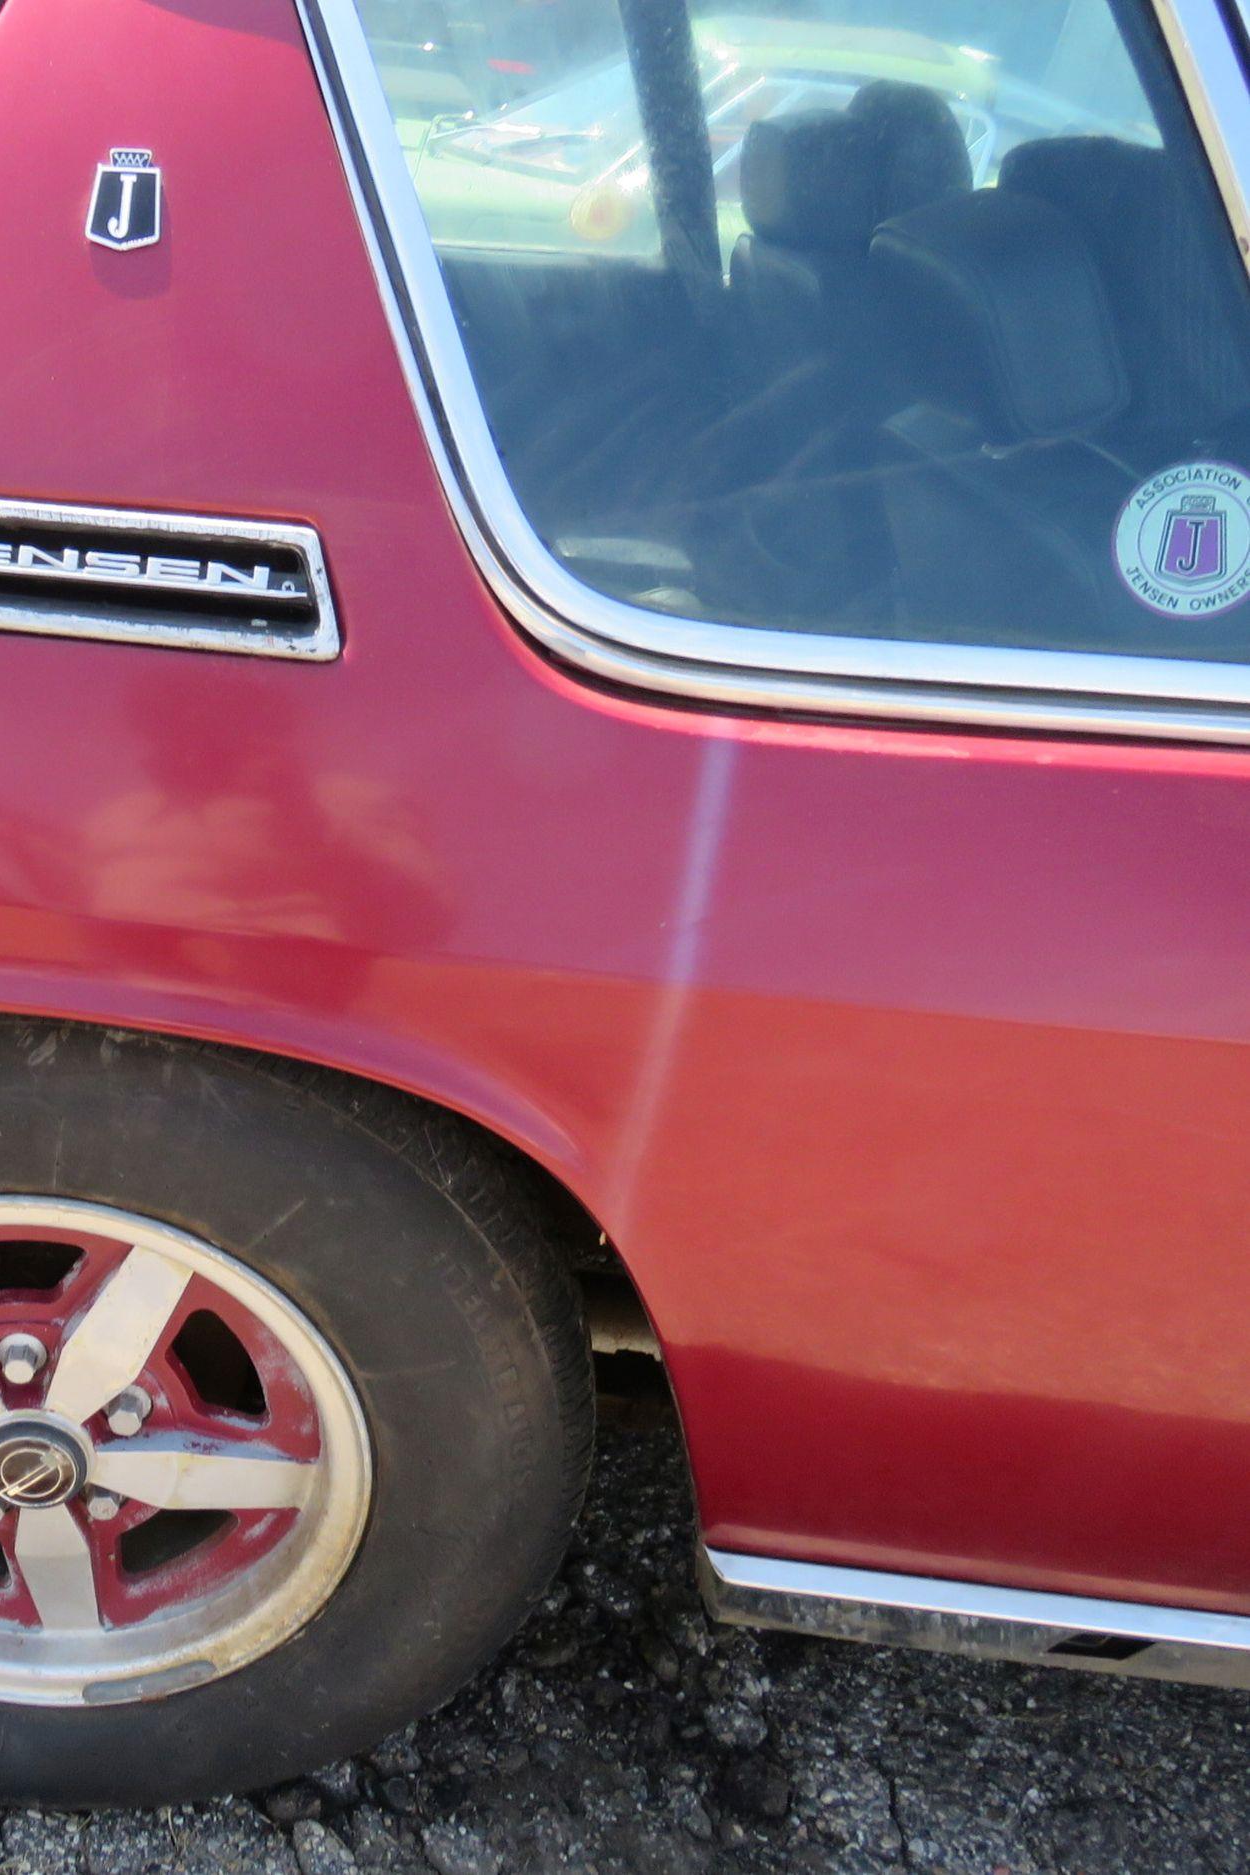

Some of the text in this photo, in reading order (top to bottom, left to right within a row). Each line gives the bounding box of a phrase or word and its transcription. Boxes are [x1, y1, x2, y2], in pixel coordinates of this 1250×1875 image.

[107, 173, 138, 239] J
[1136, 469, 1242, 510] ASSOCIATION
[1177, 521, 1205, 571] J
[1126, 566, 1179, 610] JENSEN
